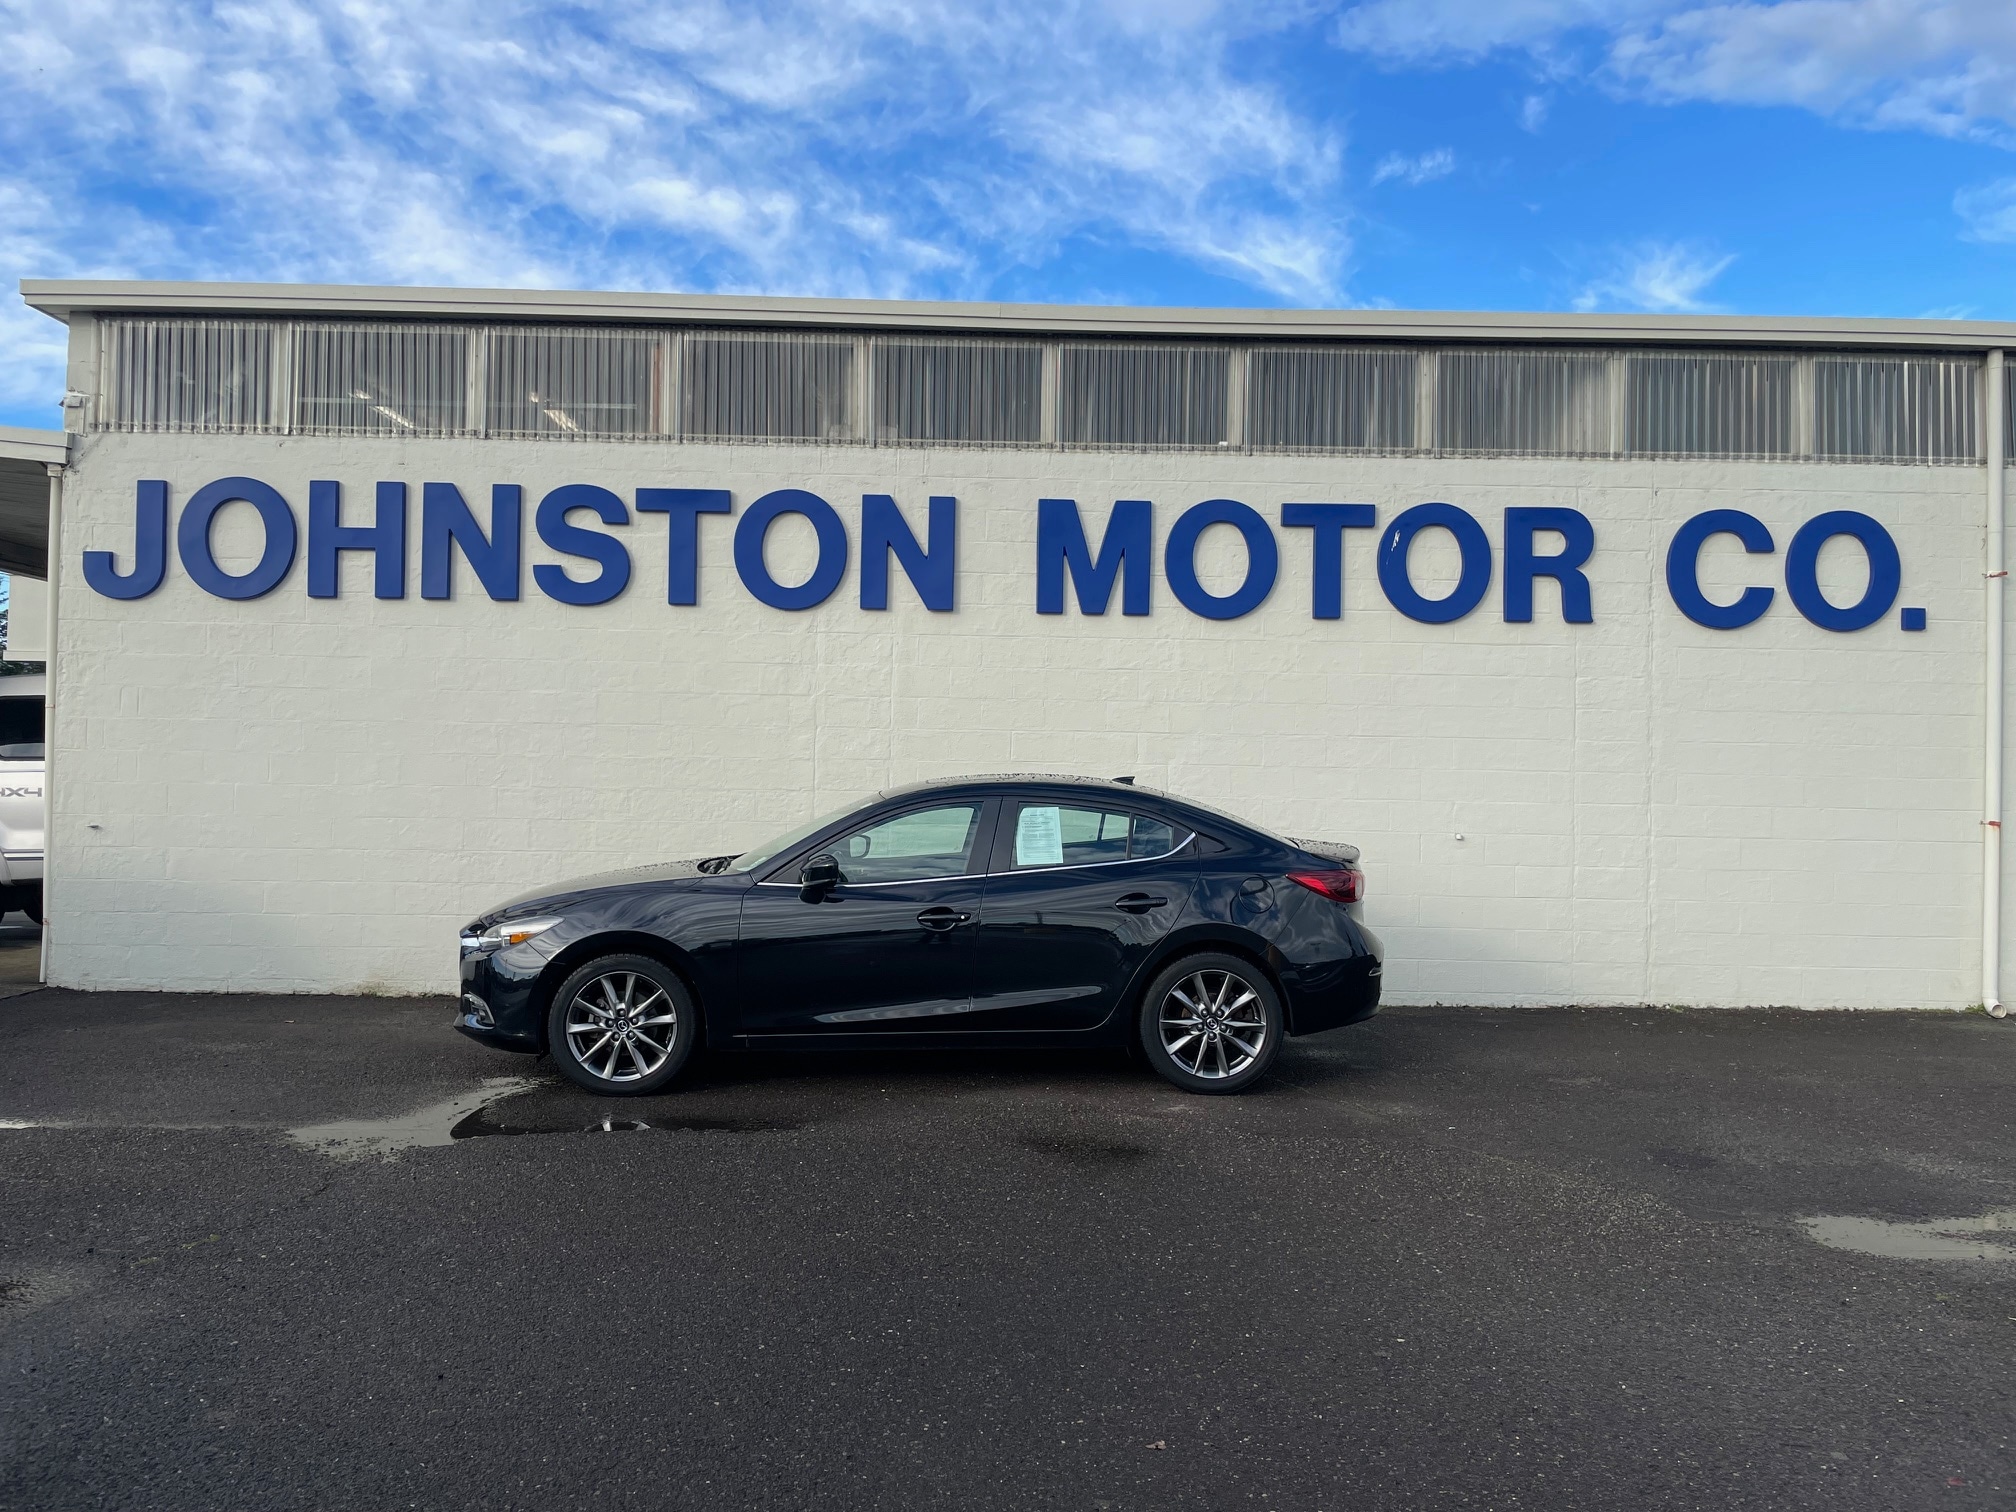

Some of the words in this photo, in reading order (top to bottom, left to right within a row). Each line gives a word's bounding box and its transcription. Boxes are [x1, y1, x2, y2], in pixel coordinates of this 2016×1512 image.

[83, 477, 956, 611] JOHNSTON
[1037, 499, 1595, 625] MOTOR
[1667, 509, 1926, 632] CO.
[0, 787, 42, 798] X4
